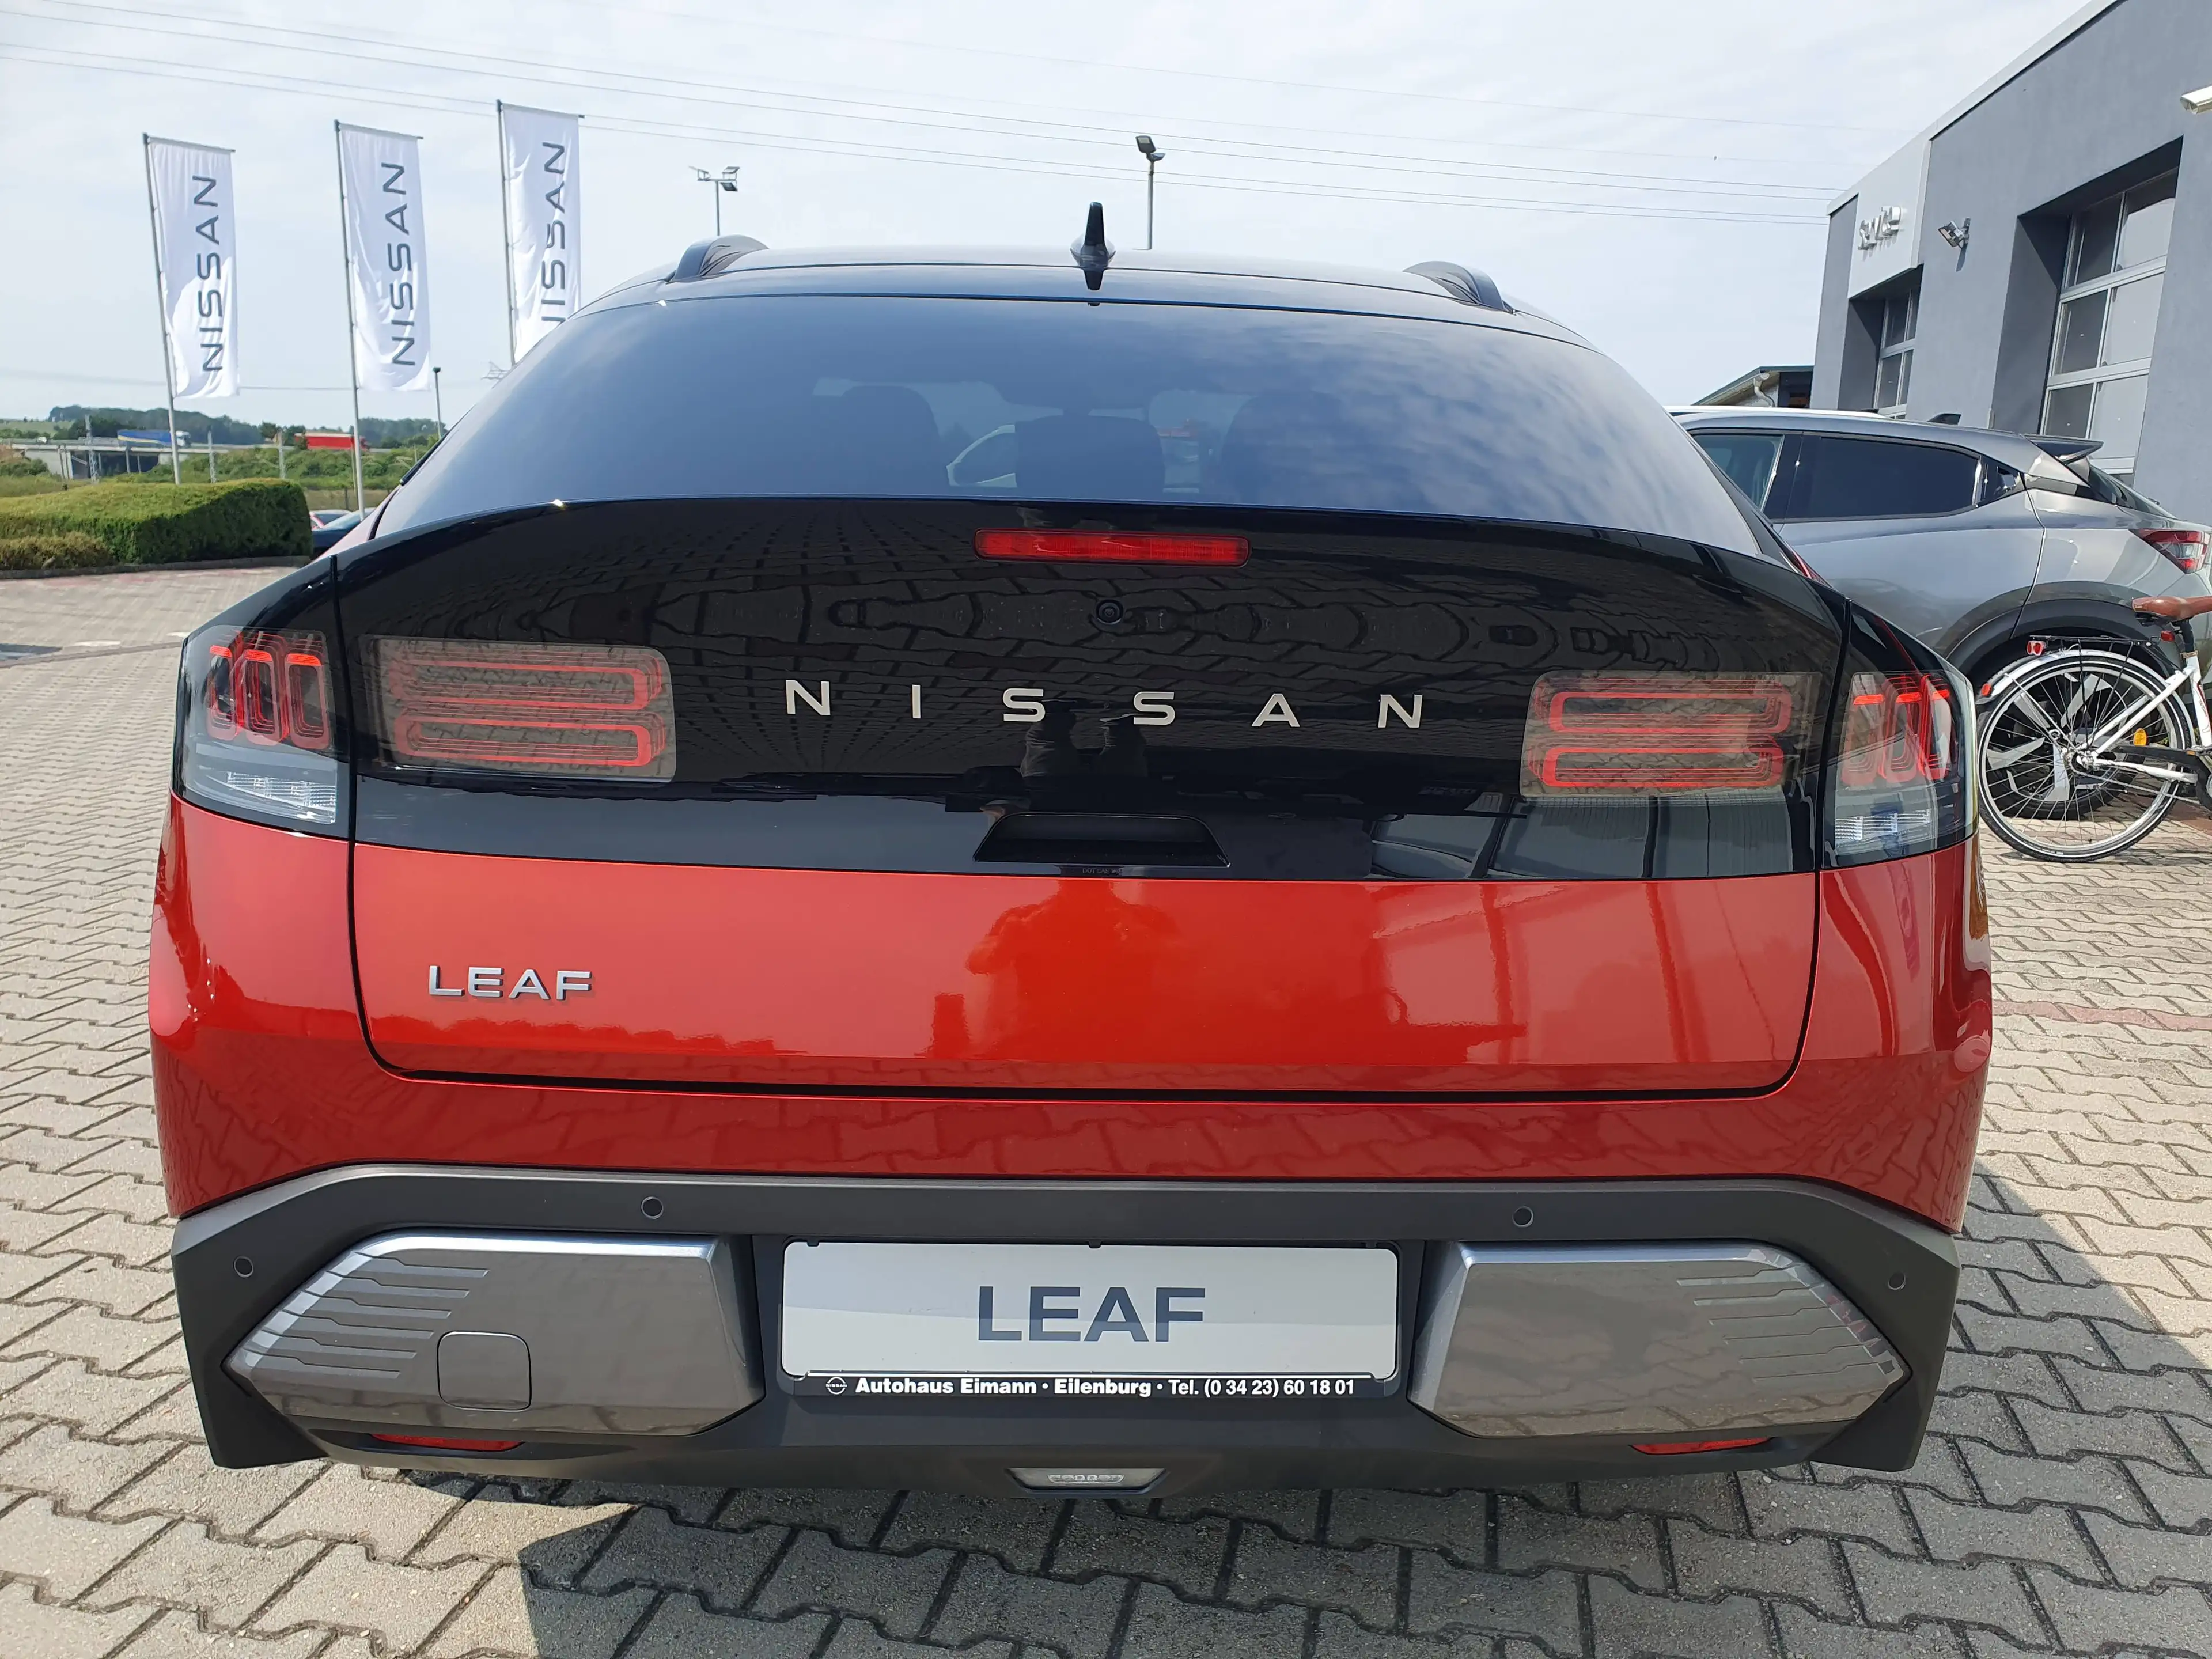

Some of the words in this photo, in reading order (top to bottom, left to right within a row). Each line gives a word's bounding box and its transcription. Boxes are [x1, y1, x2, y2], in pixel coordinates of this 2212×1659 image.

[192, 175, 223, 371] NISSAN
[381, 162, 415, 366] NISSAN
[785, 680, 1423, 728] NISSAN
[429, 965, 592, 1000] LEAF
[978, 1286, 1206, 1342] LEAF
[855, 1378, 954, 1394] Autohaus
[960, 1378, 1037, 1394] Eimann
[1054, 1378, 1152, 1397] Eilenburg
[1168, 1379, 1199, 1395] Tel.
[1205, 1379, 1221, 1398] (0
[1226, 1380, 1247, 1395] 34
[1251, 1379, 1279, 1398] 23)
[1283, 1380, 1305, 1395] 60
[1310, 1380, 1330, 1395] 18
[1334, 1380, 1354, 1395] 01
